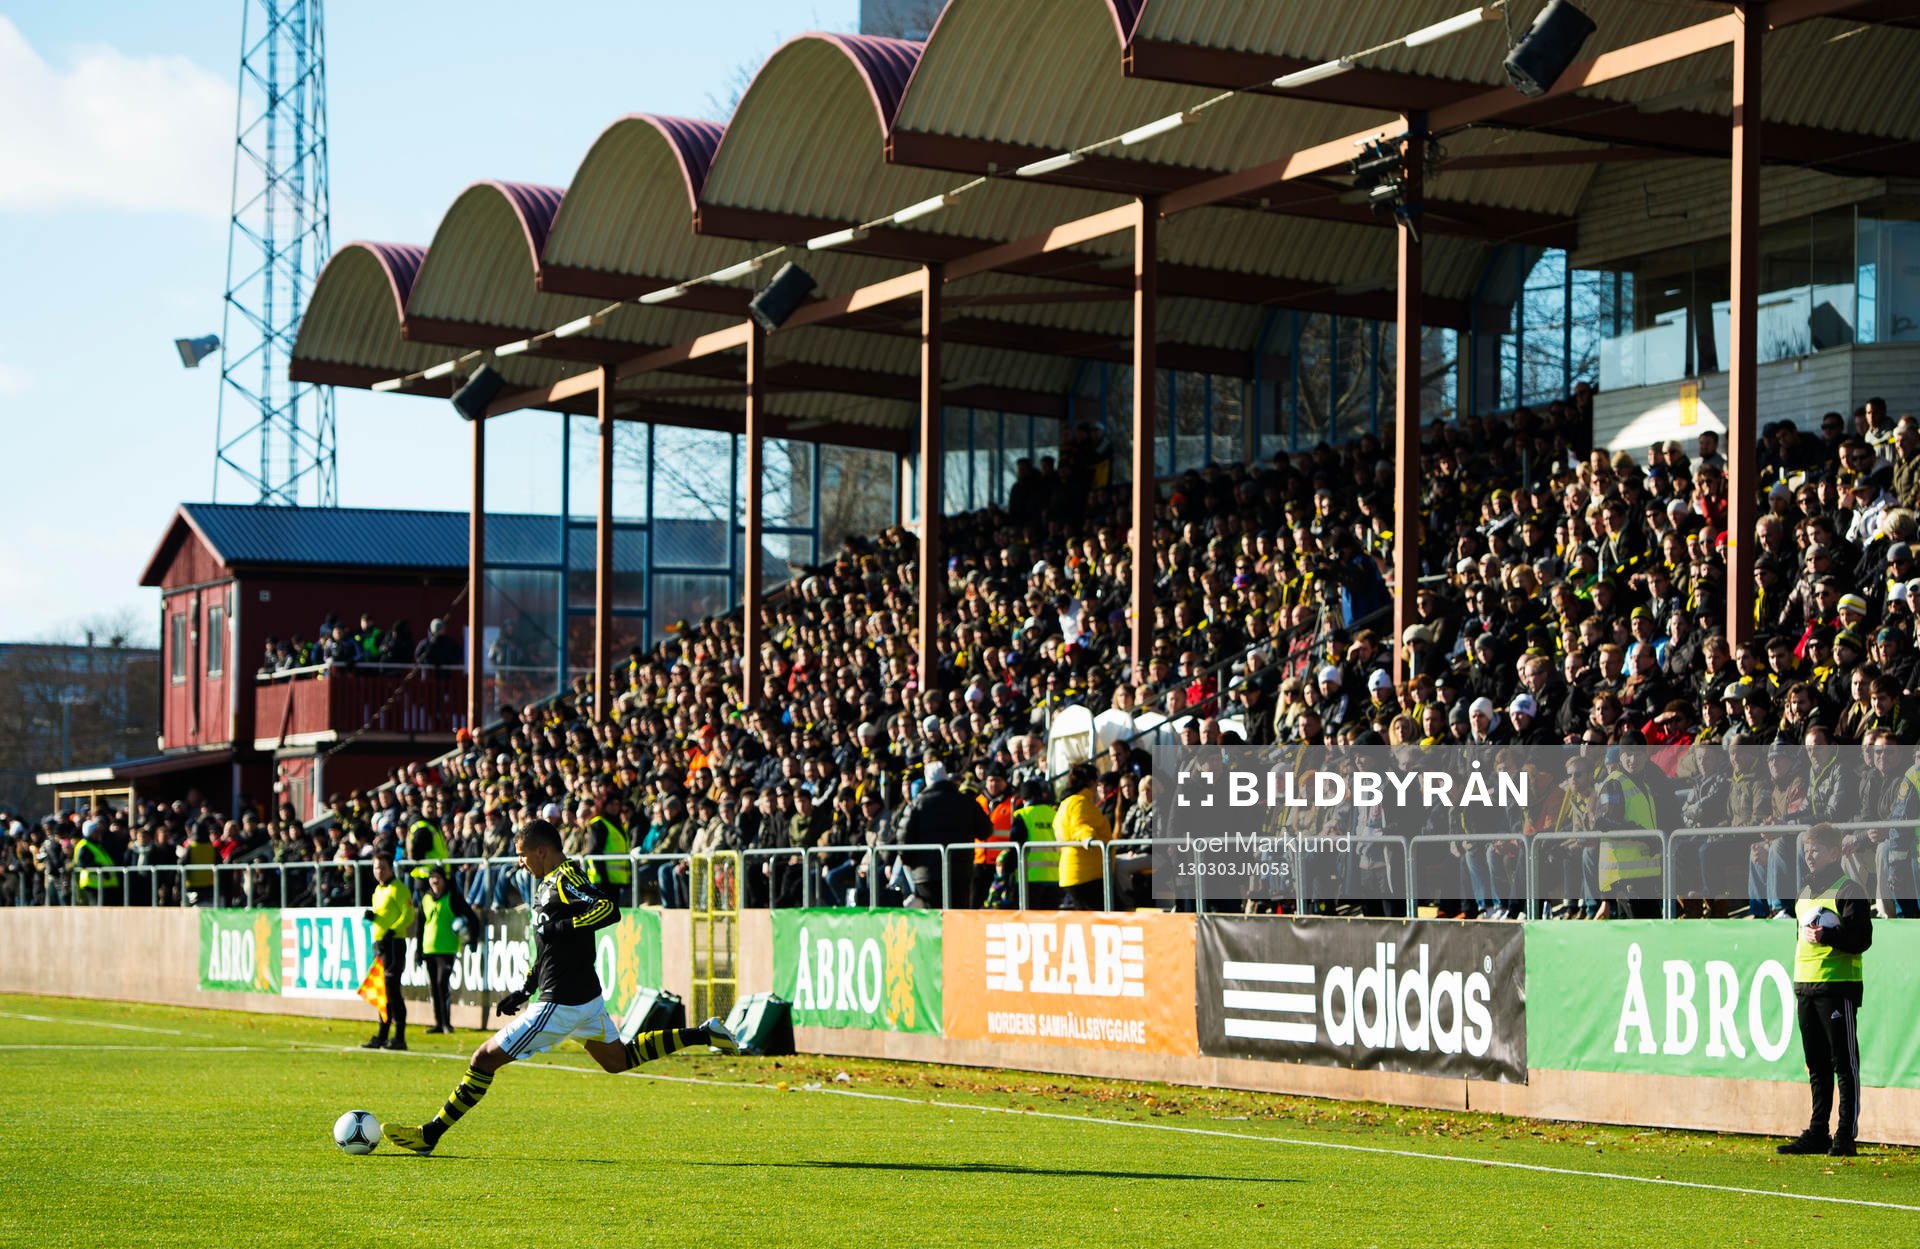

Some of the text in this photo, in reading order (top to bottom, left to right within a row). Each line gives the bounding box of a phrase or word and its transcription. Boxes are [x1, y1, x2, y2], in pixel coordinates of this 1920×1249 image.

[208, 924, 254, 984] ÅBRO
[793, 926, 883, 1014] ÅBRO
[1002, 921, 1126, 997] PEAB
[987, 1011, 1037, 1036] NORDENS
[1613, 942, 1795, 1063] ÅBRO
